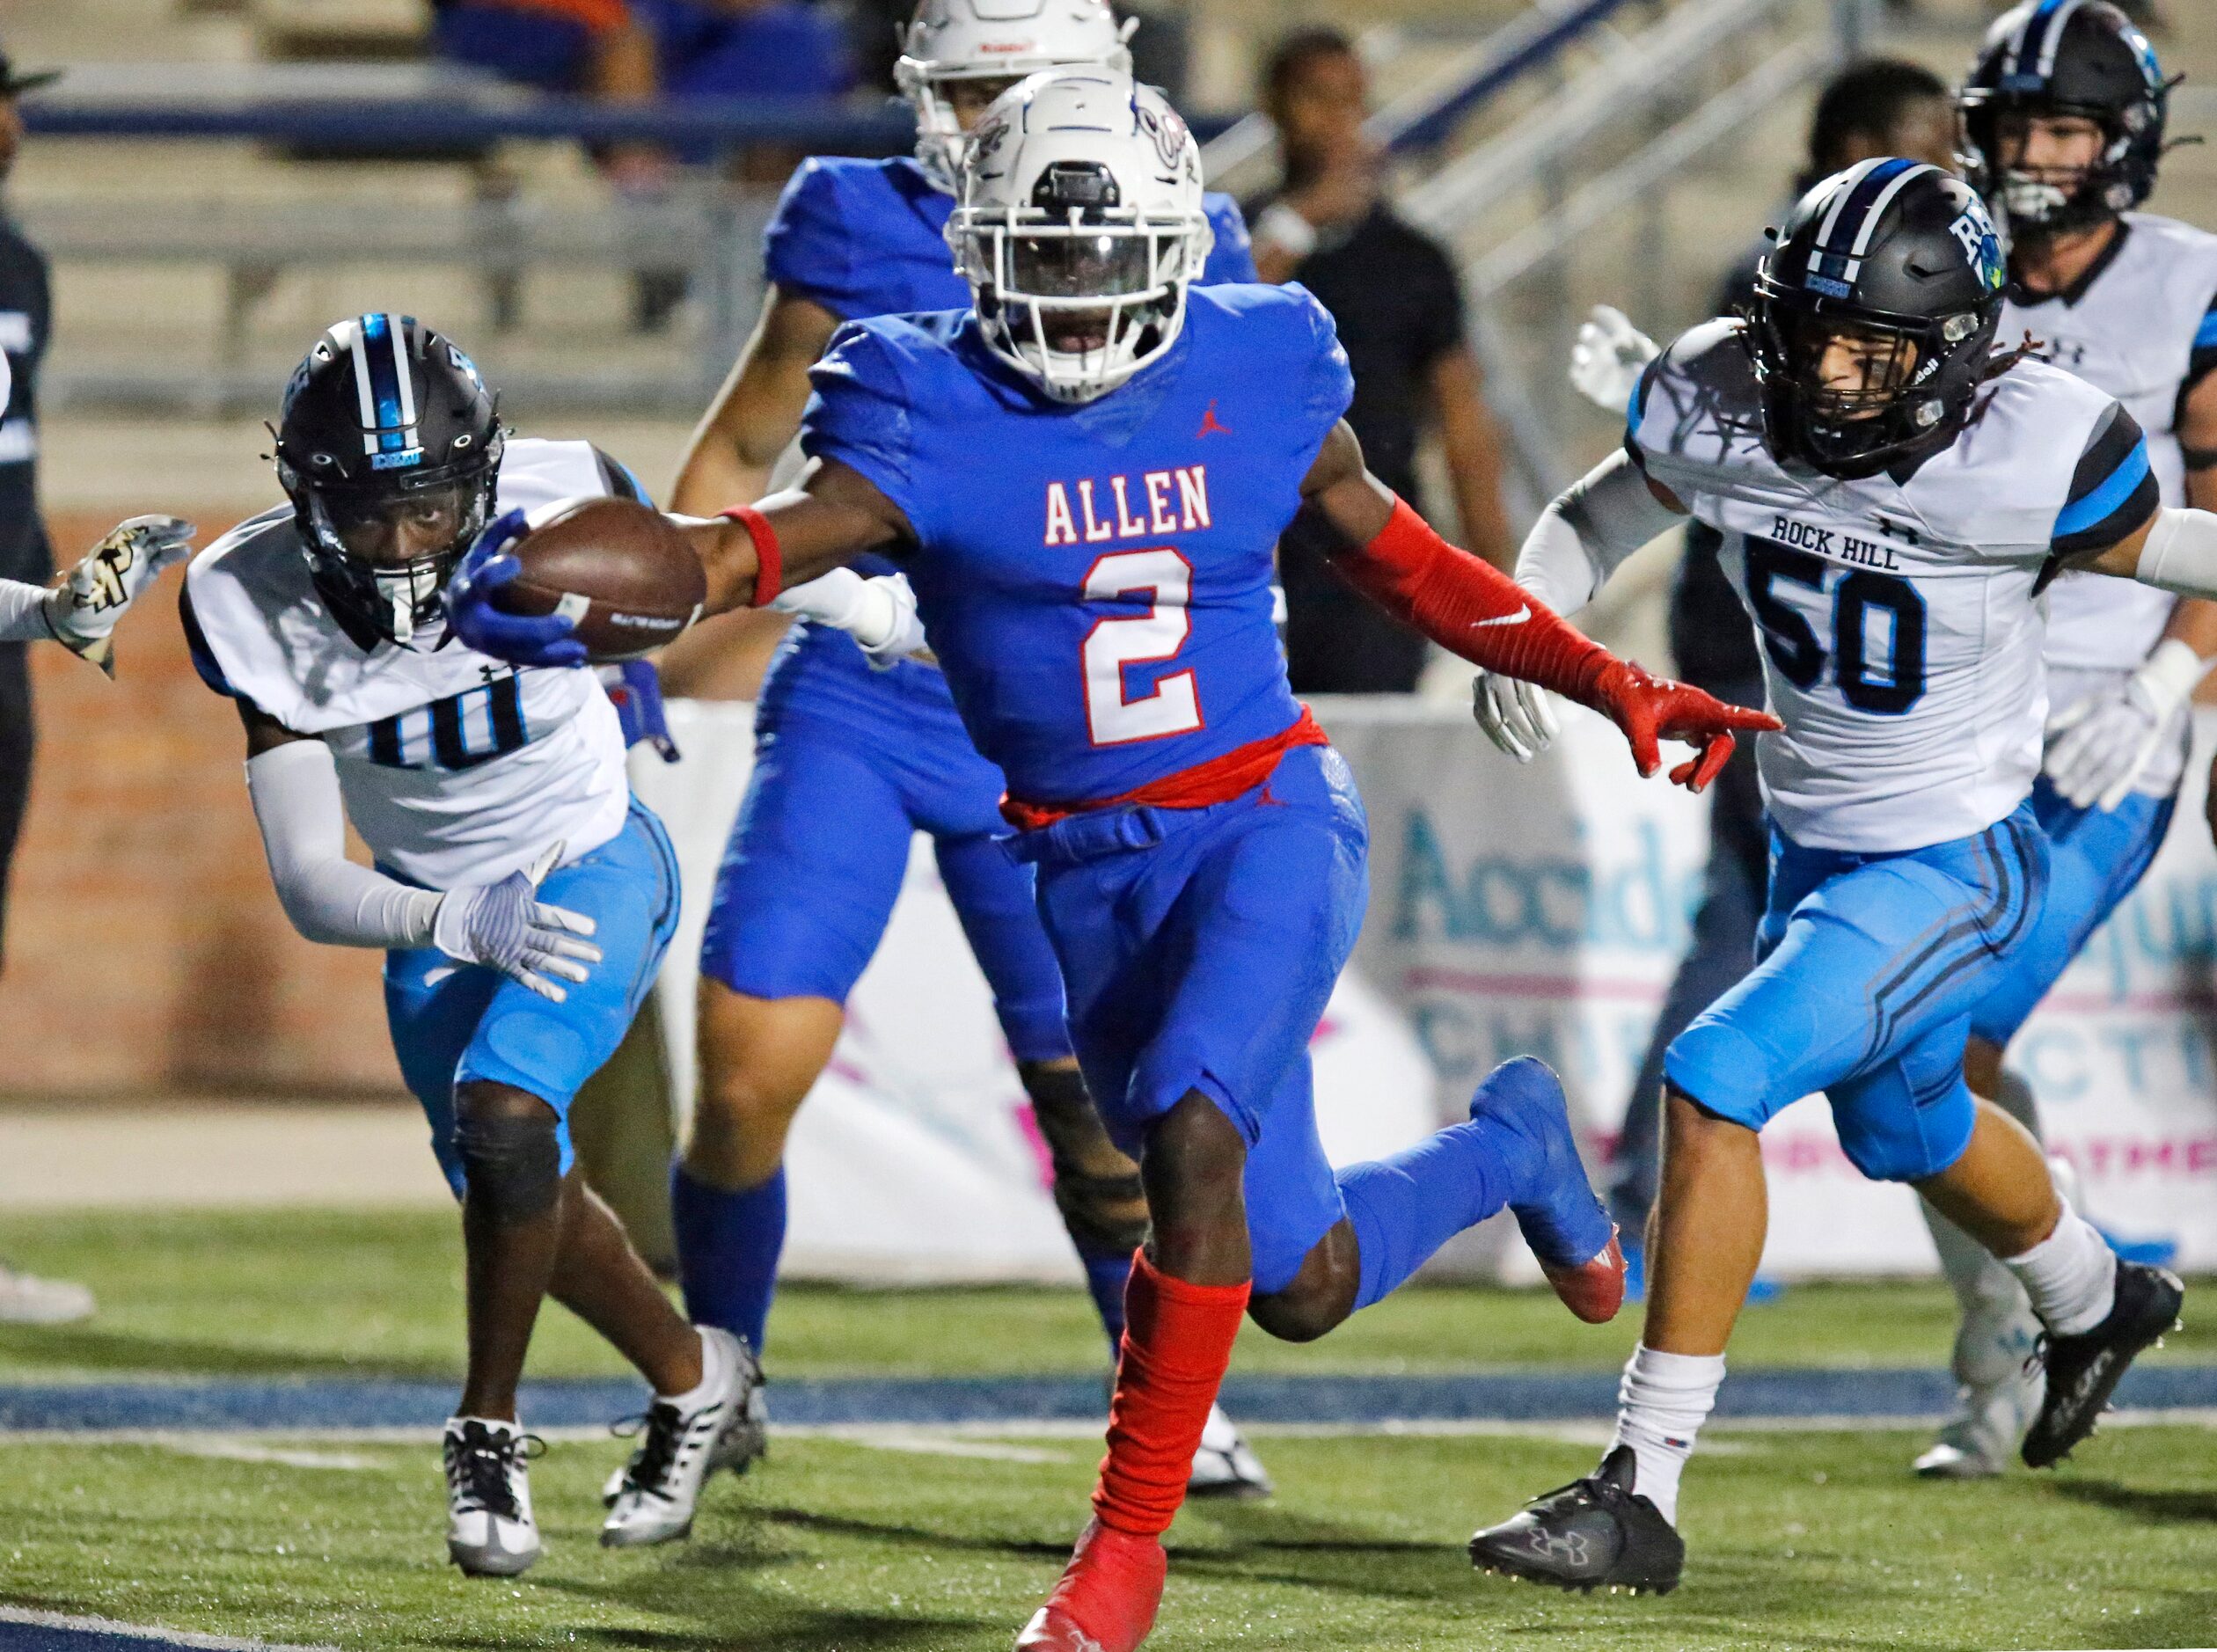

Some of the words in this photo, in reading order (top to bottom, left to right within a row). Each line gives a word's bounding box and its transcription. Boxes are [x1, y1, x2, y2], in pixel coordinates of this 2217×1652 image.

[1044, 464, 1211, 545] ALLEN
[1771, 515, 1835, 555] ROCK
[1840, 536, 1899, 571] HILL
[1079, 545, 1206, 748] 2
[1743, 532, 1928, 717] 50
[366, 676, 529, 772] 10
